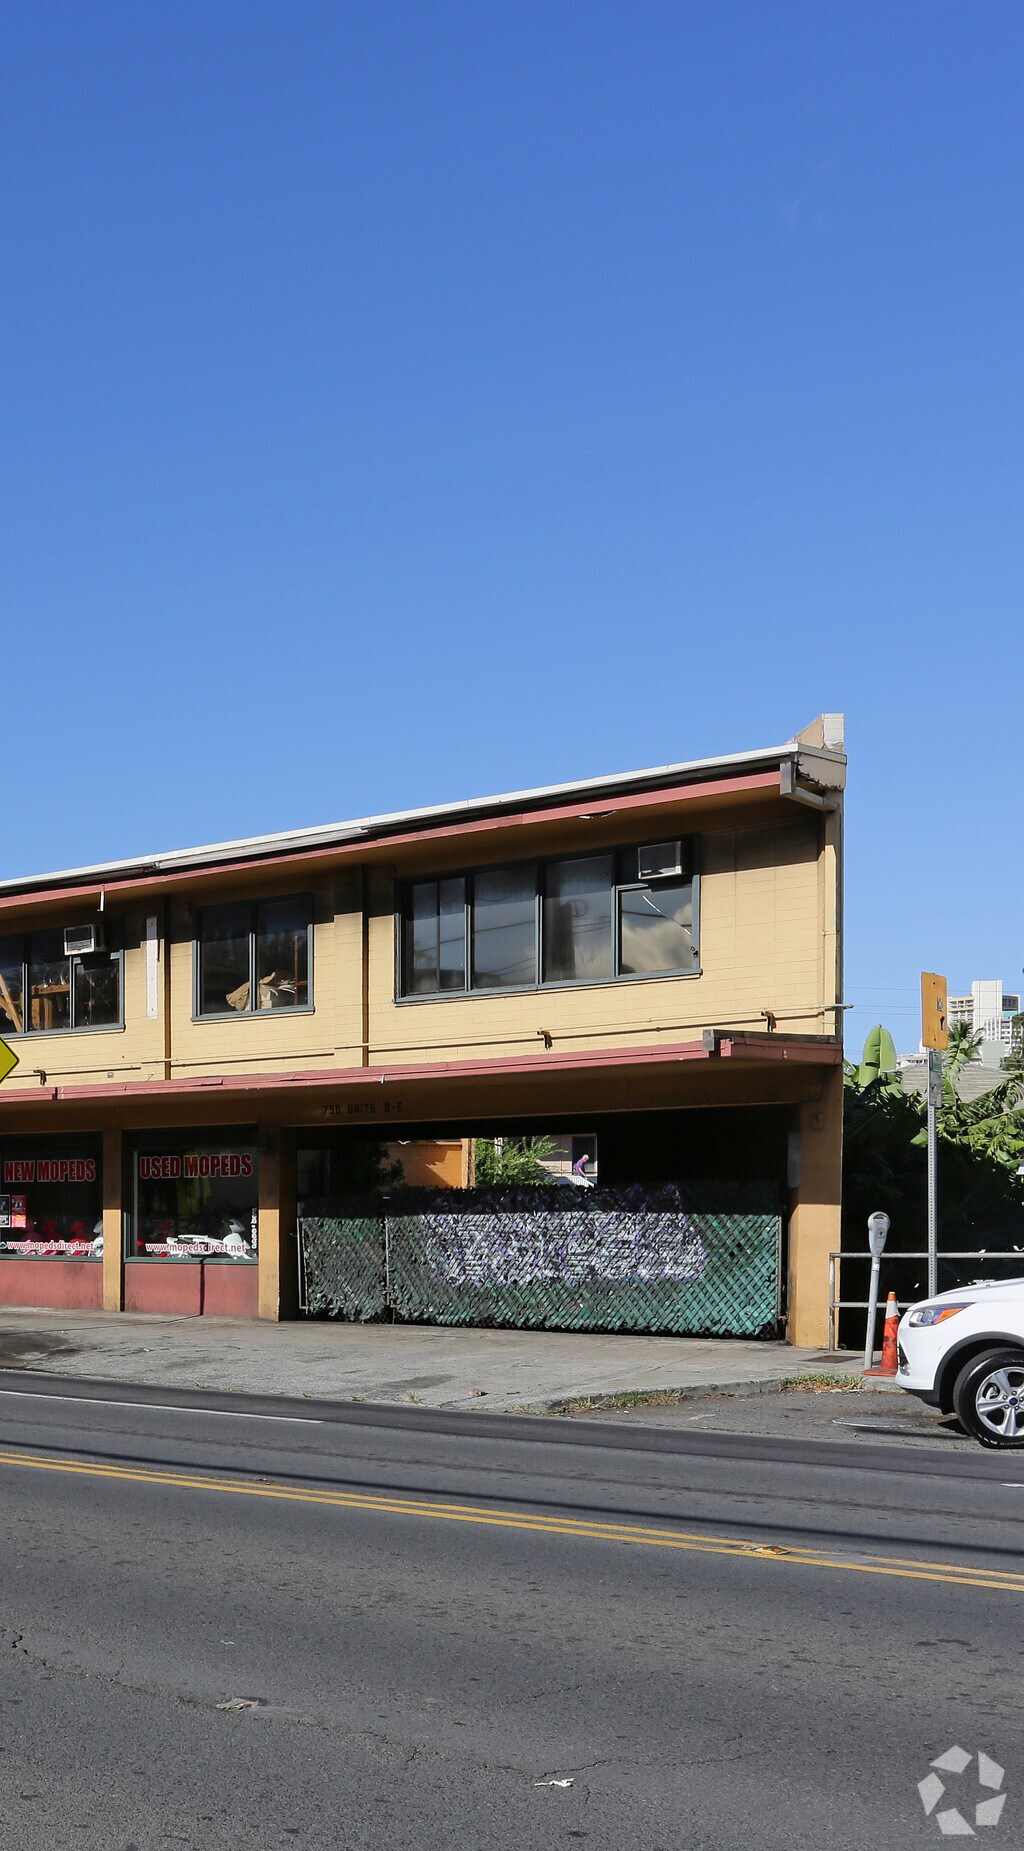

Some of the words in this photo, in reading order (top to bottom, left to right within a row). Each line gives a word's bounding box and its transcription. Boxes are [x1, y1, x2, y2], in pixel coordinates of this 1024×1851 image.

[322, 1104, 341, 1115] 750
[348, 1103, 376, 1114] UNITS
[4, 1160, 35, 1183] NEW
[37, 1158, 96, 1183] MOPEDS
[139, 1155, 181, 1179] USED
[183, 1153, 253, 1178] MOPEDS
[6, 1239, 95, 1251] www.mopedsdirect.net
[145, 1241, 247, 1253] www.mopedsdirect.net
